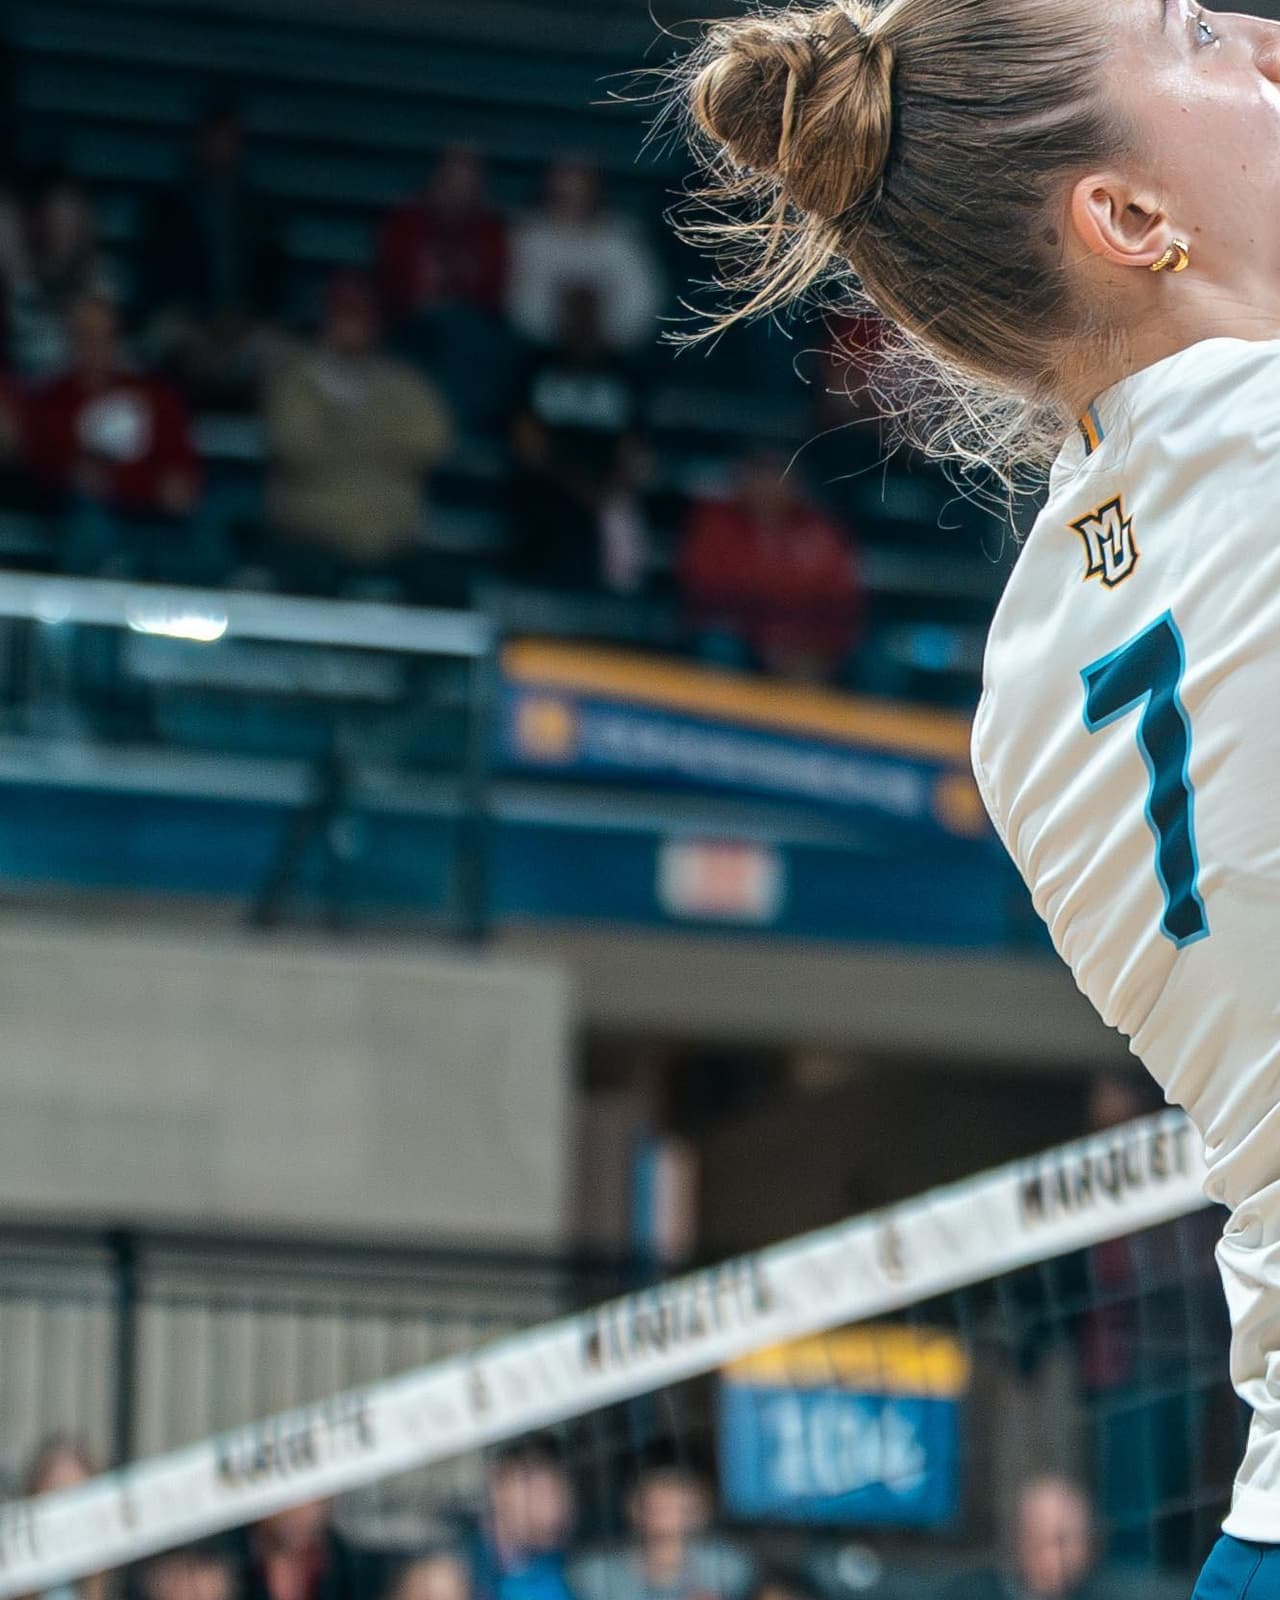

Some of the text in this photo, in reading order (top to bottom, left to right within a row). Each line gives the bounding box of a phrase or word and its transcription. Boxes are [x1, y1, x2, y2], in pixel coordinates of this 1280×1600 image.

[1067, 494, 1141, 590] MU
[1079, 608, 1211, 951] 7
[1019, 1122, 1192, 1228] MARQUET
